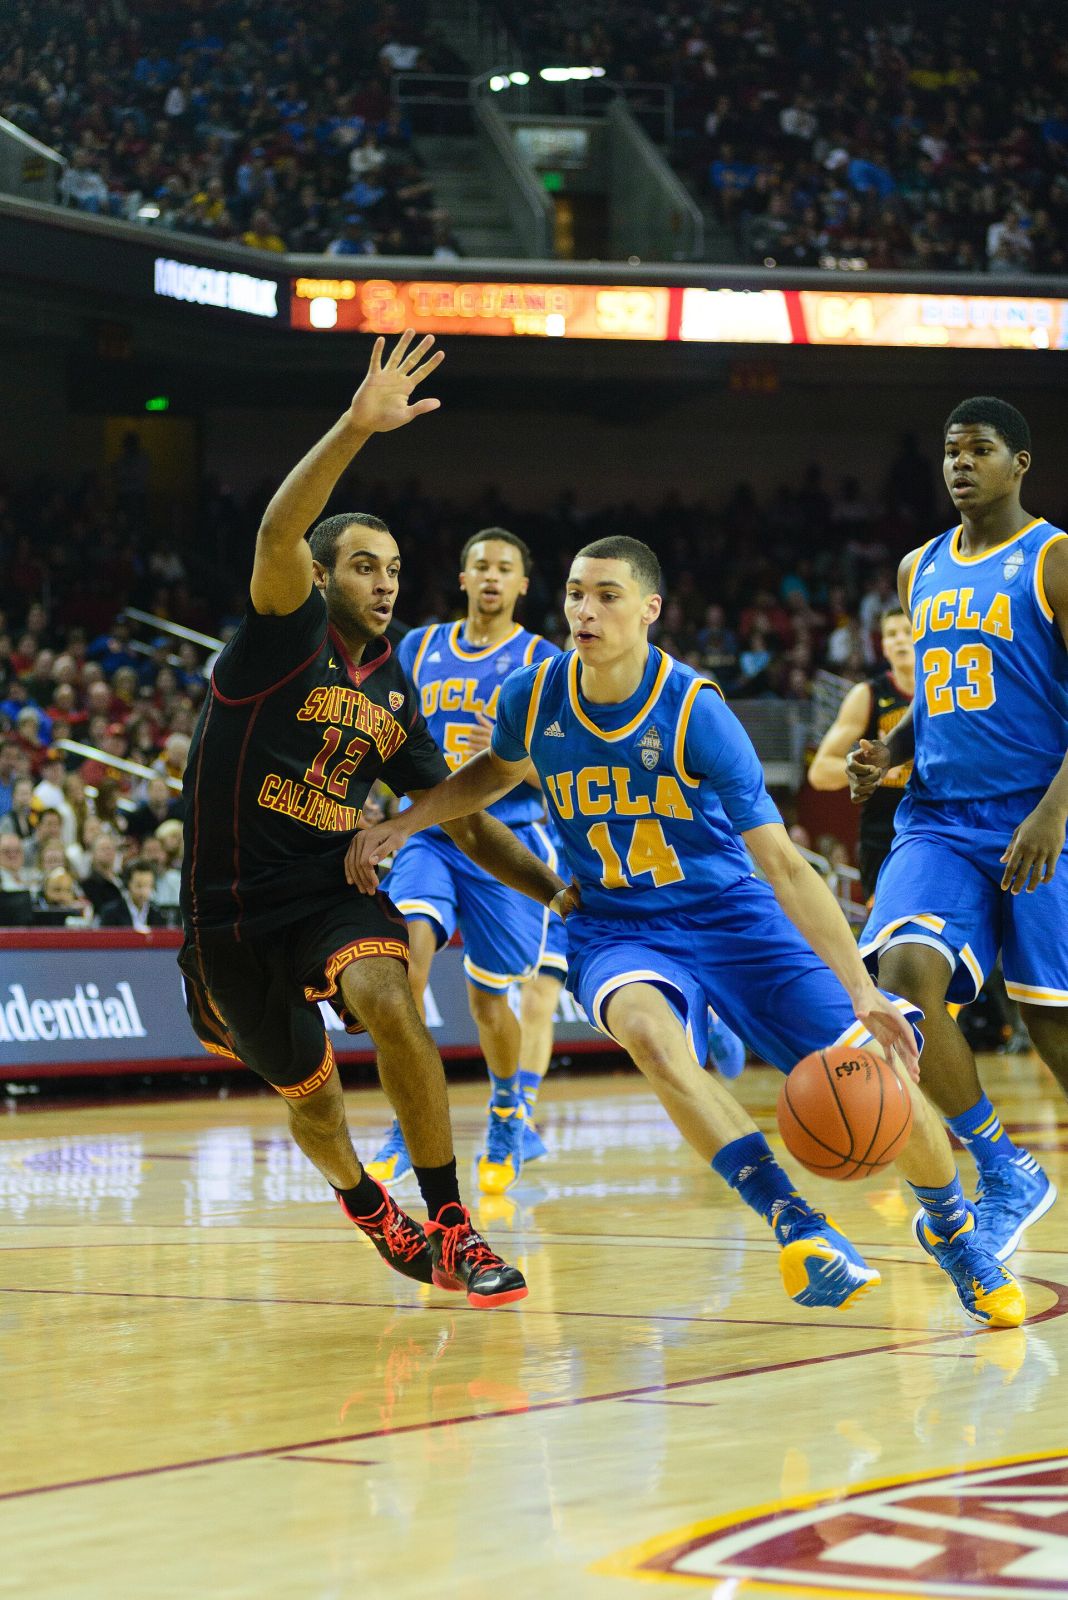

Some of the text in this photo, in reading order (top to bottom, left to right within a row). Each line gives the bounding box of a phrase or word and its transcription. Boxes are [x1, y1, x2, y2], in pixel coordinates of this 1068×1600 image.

[912, 587, 1014, 645] UCLA
[923, 643, 996, 717] 23
[297, 686, 407, 763] SOUTHERN
[443, 721, 474, 773] 5
[304, 726, 371, 799] 12
[545, 766, 693, 820] UCLA
[586, 819, 686, 889] 14
